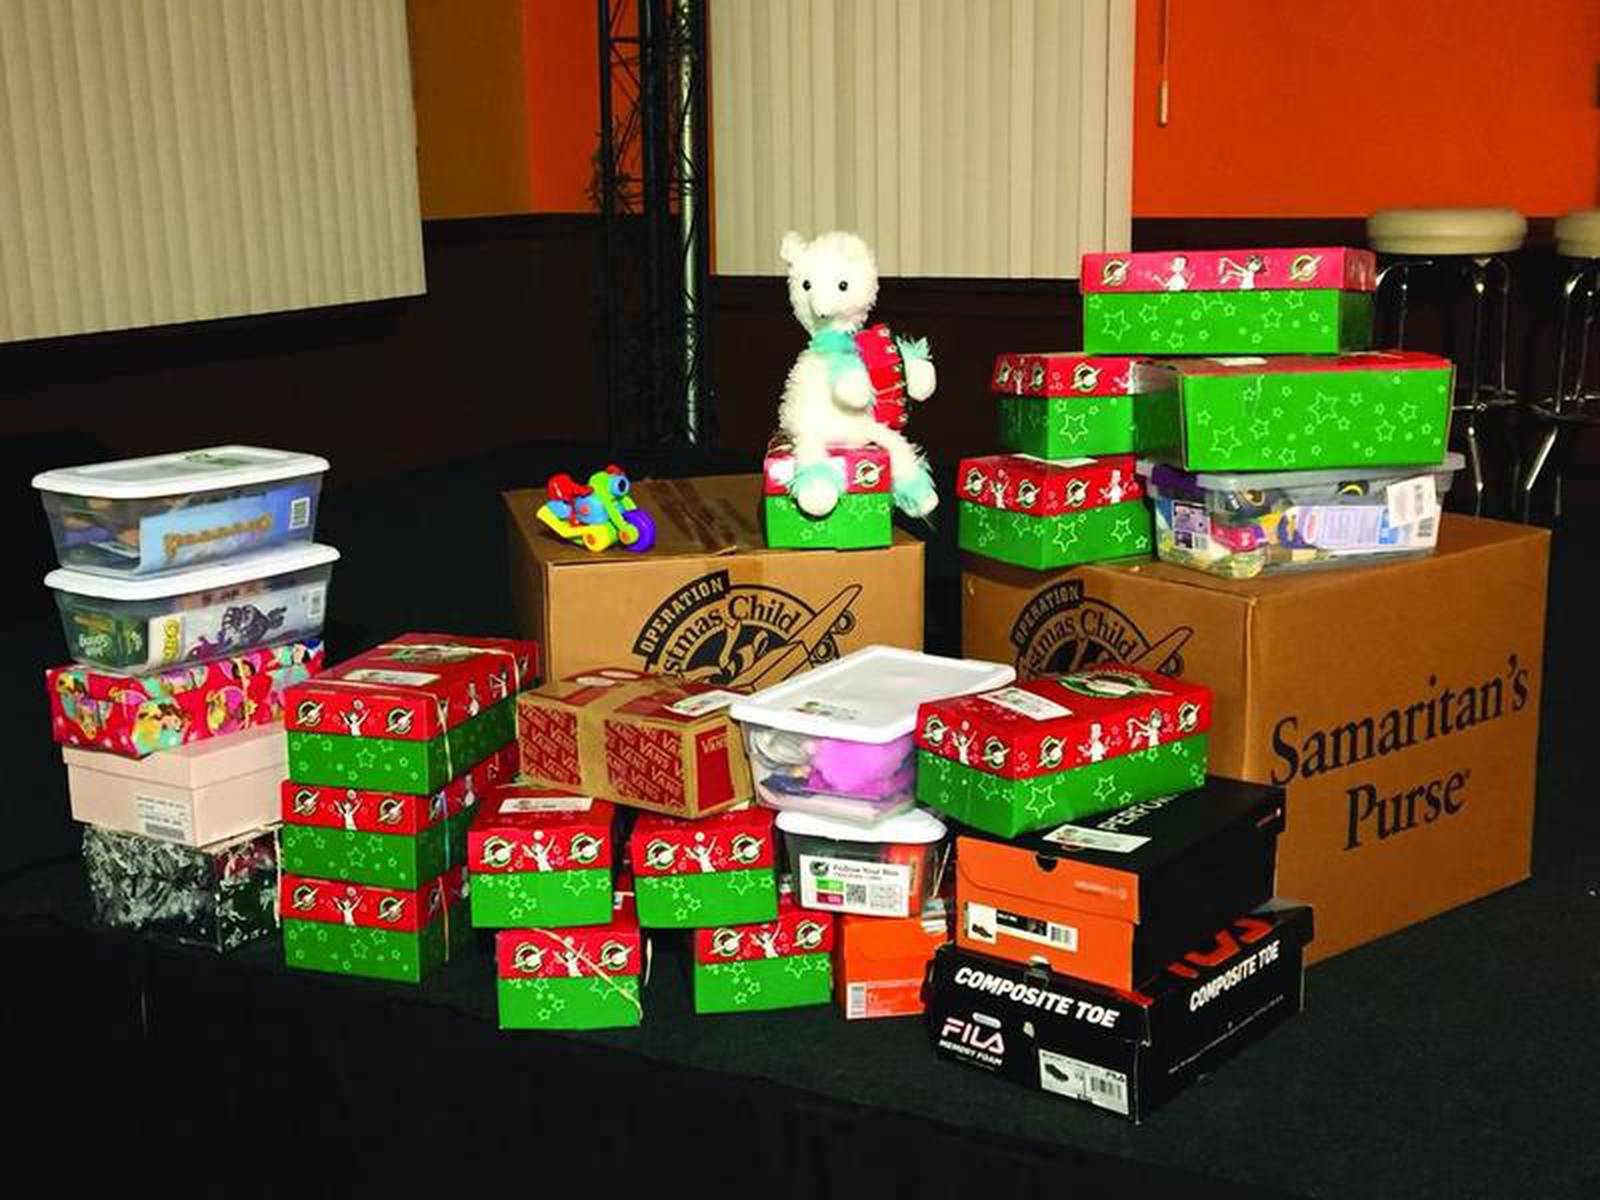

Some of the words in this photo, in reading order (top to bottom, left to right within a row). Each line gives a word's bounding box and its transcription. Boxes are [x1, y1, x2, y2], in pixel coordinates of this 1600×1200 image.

[640, 577, 724, 653] OPERATION
[663, 608, 724, 677] stmas
[727, 594, 801, 634] Child
[1014, 584, 1079, 645] OPERATION
[1080, 608, 1138, 660] Child
[1270, 653, 1530, 787] Samaritan's
[954, 966, 1075, 1015] COMPOSITE
[1075, 1001, 1121, 1028] TOE
[1189, 954, 1257, 1012] COMPOSITE
[1258, 939, 1281, 968] TOE
[941, 1017, 1005, 1055] FILA
[976, 1051, 1003, 1066] FOAM
